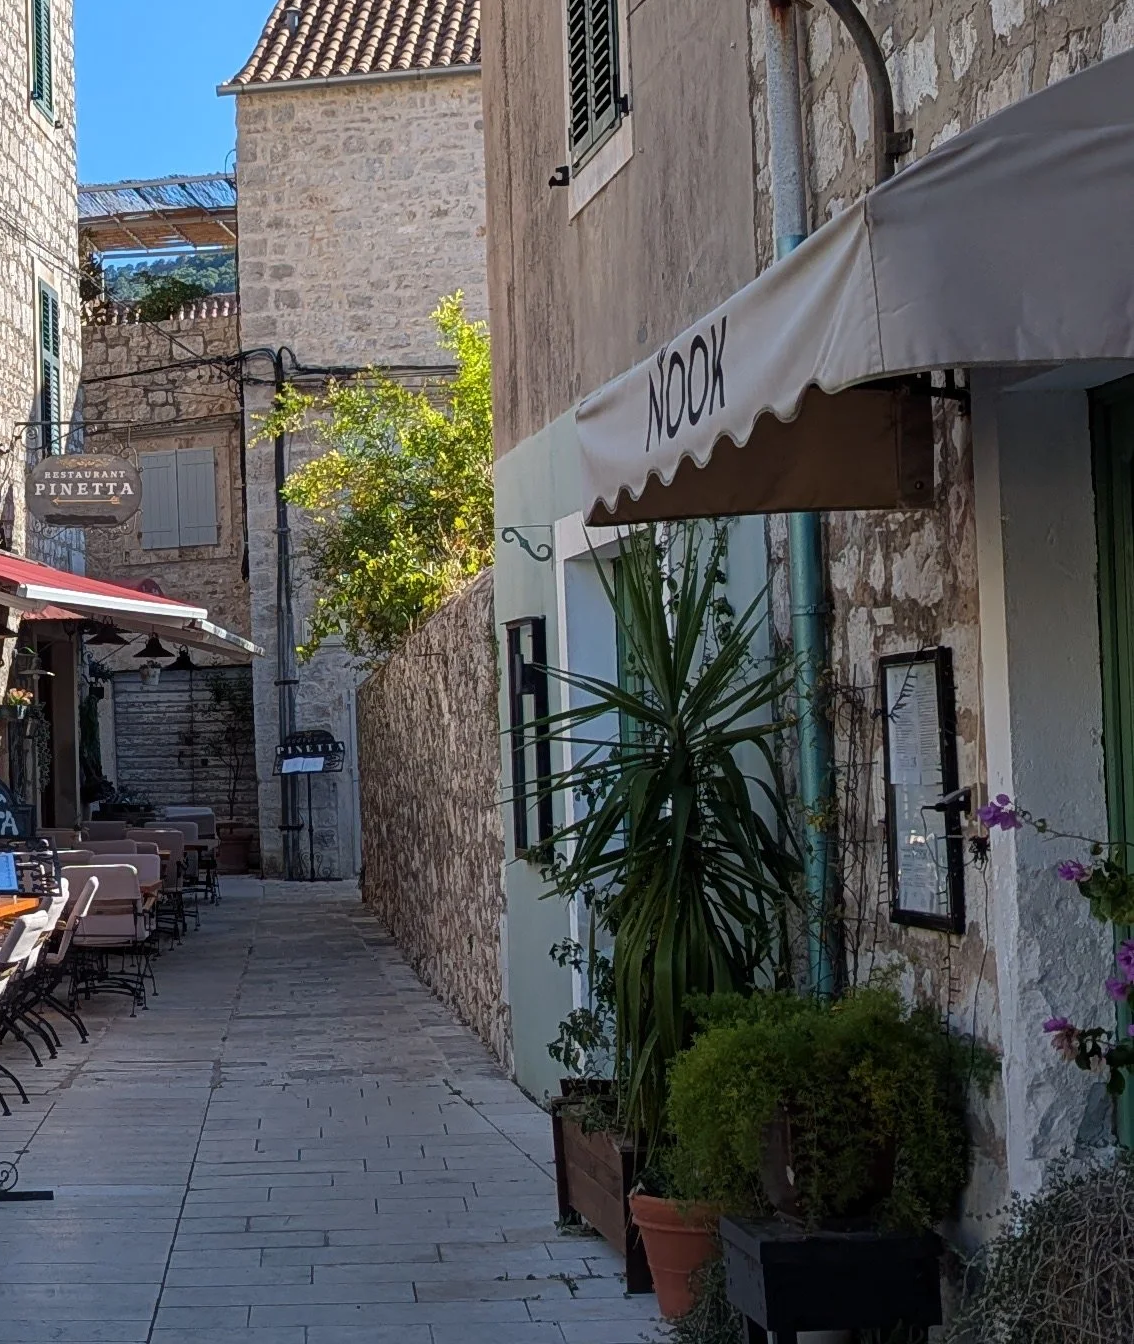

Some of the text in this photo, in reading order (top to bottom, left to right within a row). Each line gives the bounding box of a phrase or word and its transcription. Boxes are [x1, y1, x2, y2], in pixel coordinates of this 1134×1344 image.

[645, 315, 728, 452] NOOK
[44, 470, 126, 479] RESTAURANT
[34, 482, 135, 496] PINETTA
[277, 743, 344, 755] PINETTA
